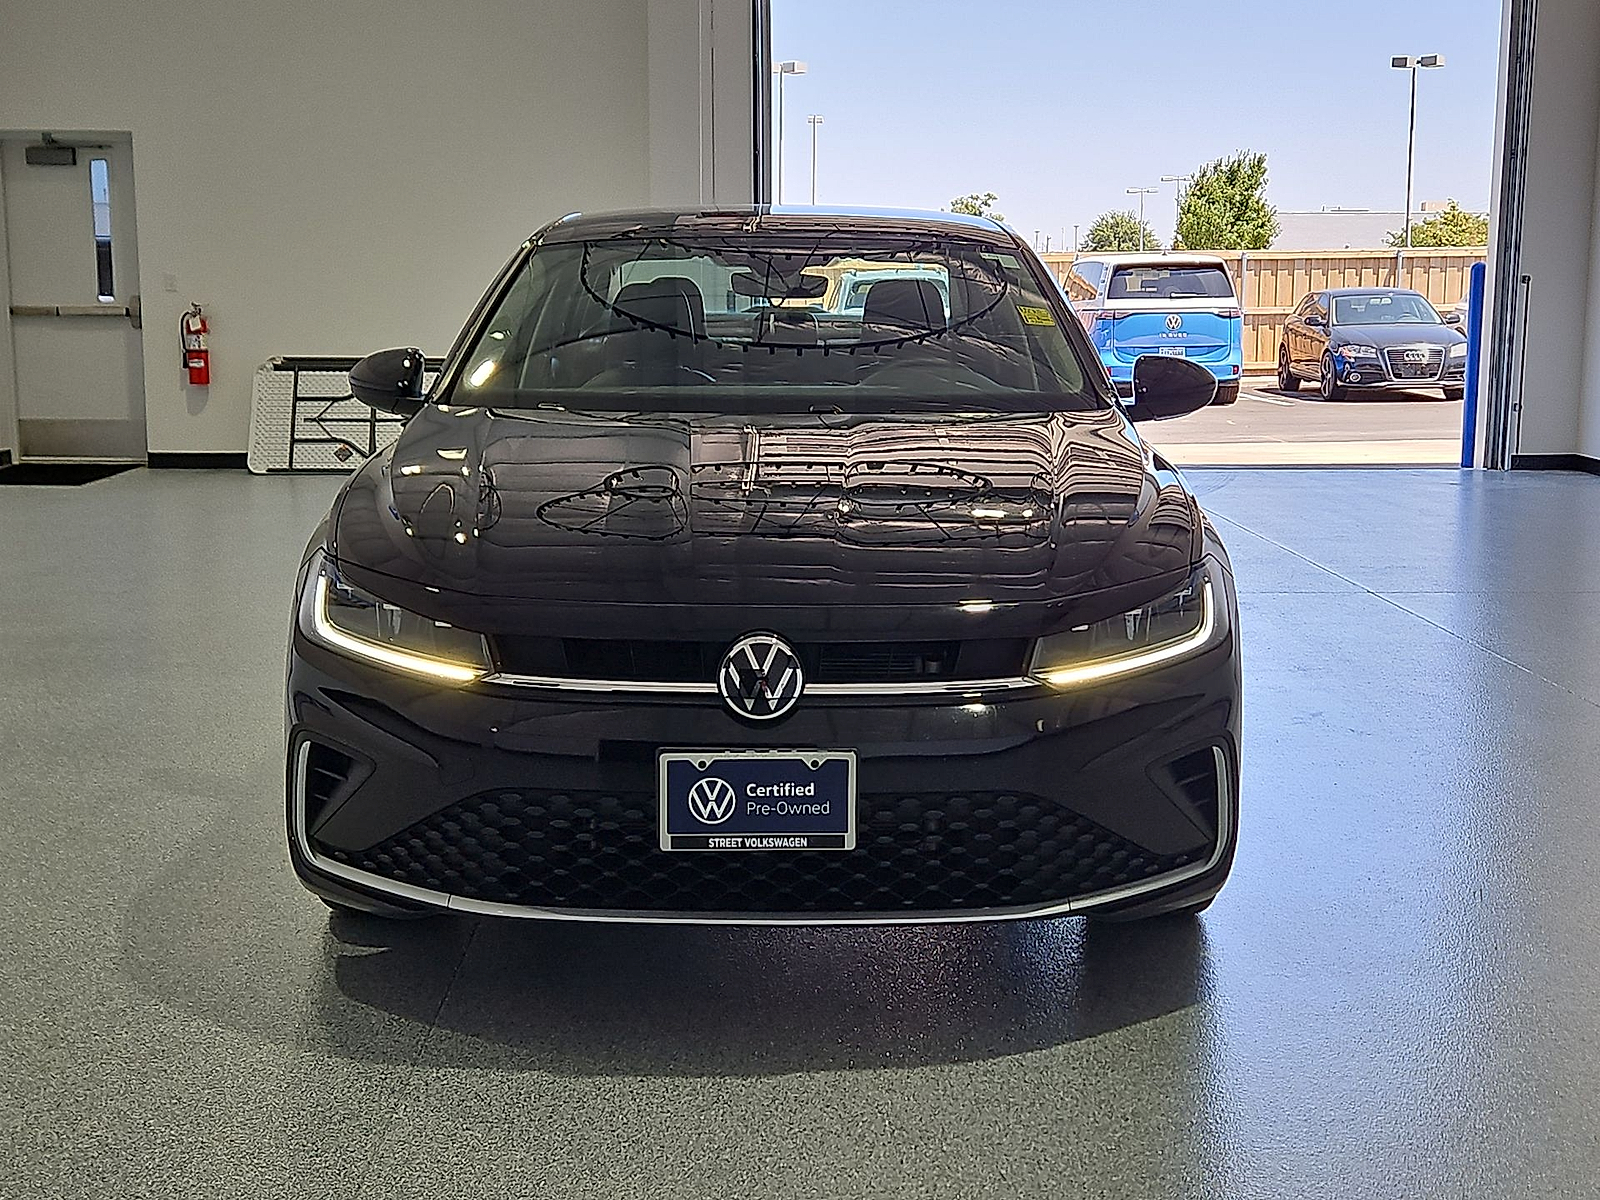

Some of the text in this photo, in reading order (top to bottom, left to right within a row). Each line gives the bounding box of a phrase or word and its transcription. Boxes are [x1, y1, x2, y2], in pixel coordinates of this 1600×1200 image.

[746, 782, 815, 797] Certified
[746, 800, 830, 815] Pre-Owned
[708, 837, 808, 848] STREET VOLKSWAGEN
